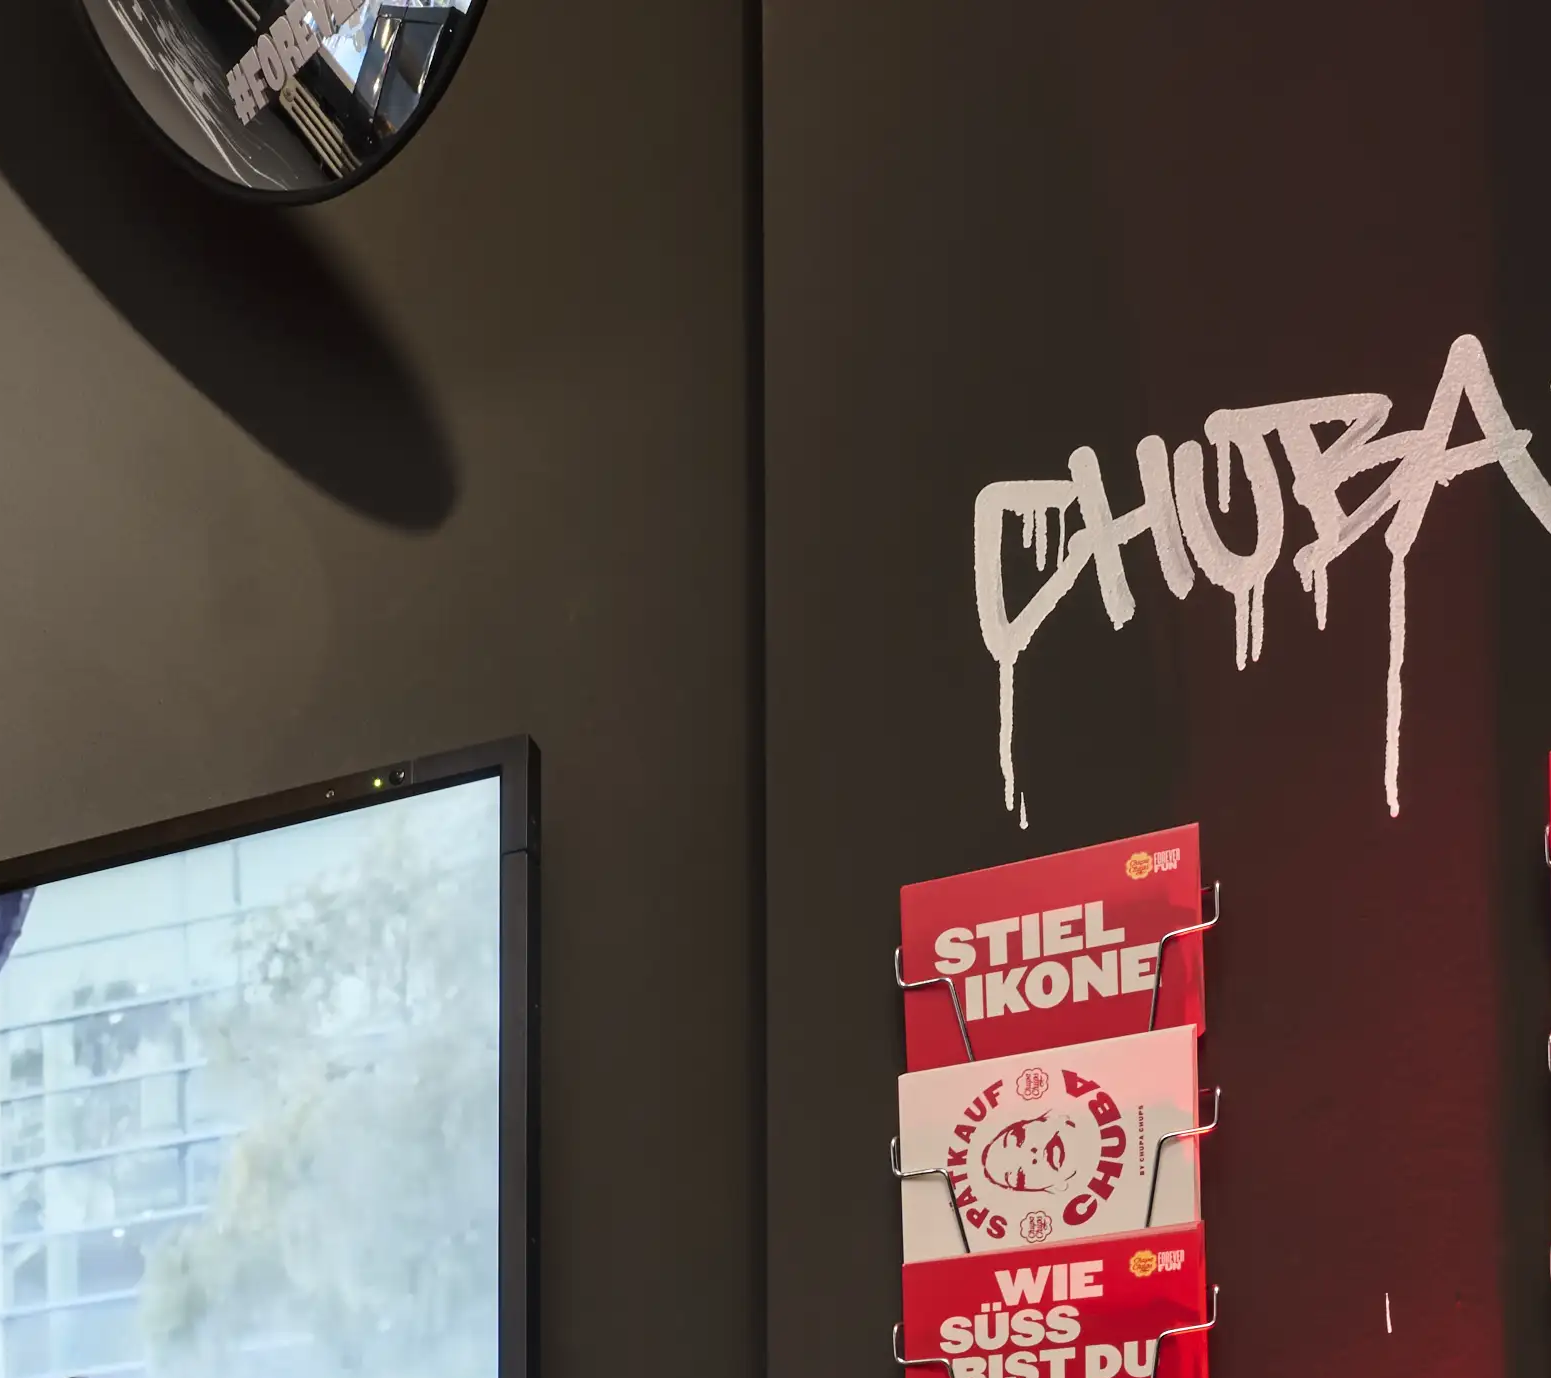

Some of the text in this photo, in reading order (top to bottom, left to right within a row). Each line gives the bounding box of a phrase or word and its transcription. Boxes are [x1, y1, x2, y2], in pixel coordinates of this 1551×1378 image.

[934, 901, 1125, 976] STIEL
[966, 941, 1162, 1022] IKONE
[1060, 1068, 1128, 1227] CHUBA
[995, 1259, 1103, 1307] WIE
[940, 1303, 1081, 1355] SÜSS
